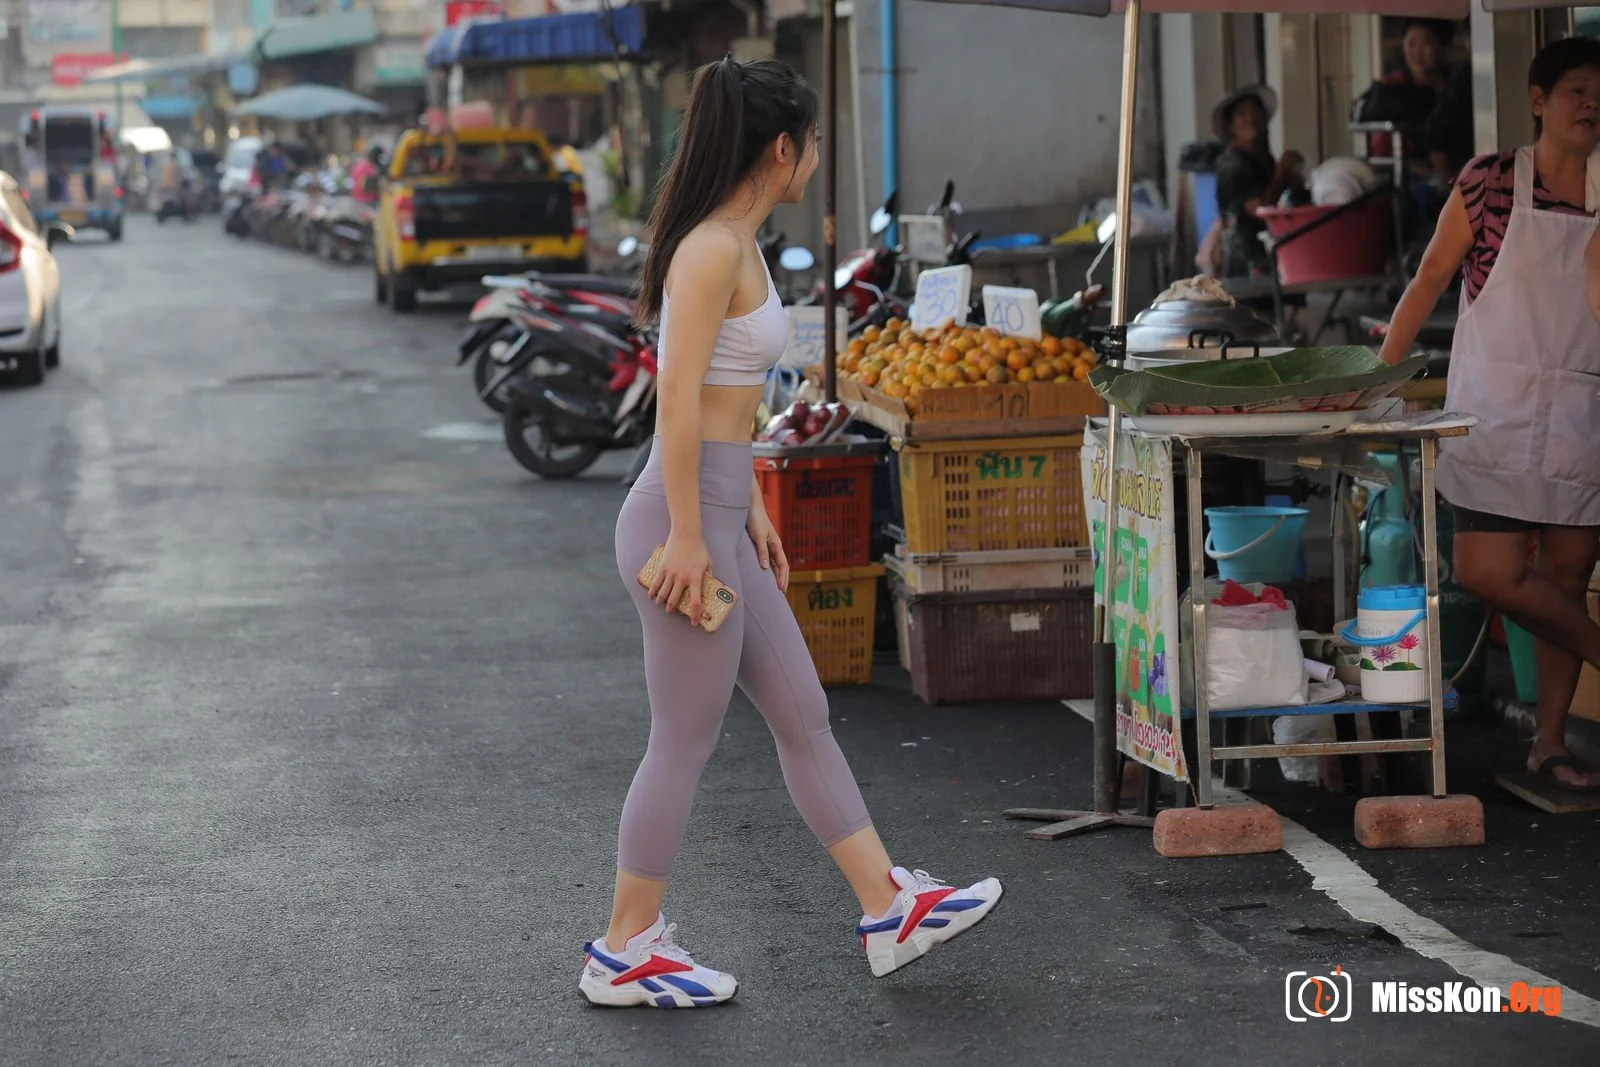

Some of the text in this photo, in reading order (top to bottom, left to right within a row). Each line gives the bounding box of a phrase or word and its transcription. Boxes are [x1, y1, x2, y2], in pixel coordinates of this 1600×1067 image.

[921, 289, 958, 325] 30
[990, 301, 1024, 337] 40
[1028, 455, 1047, 478] 7
